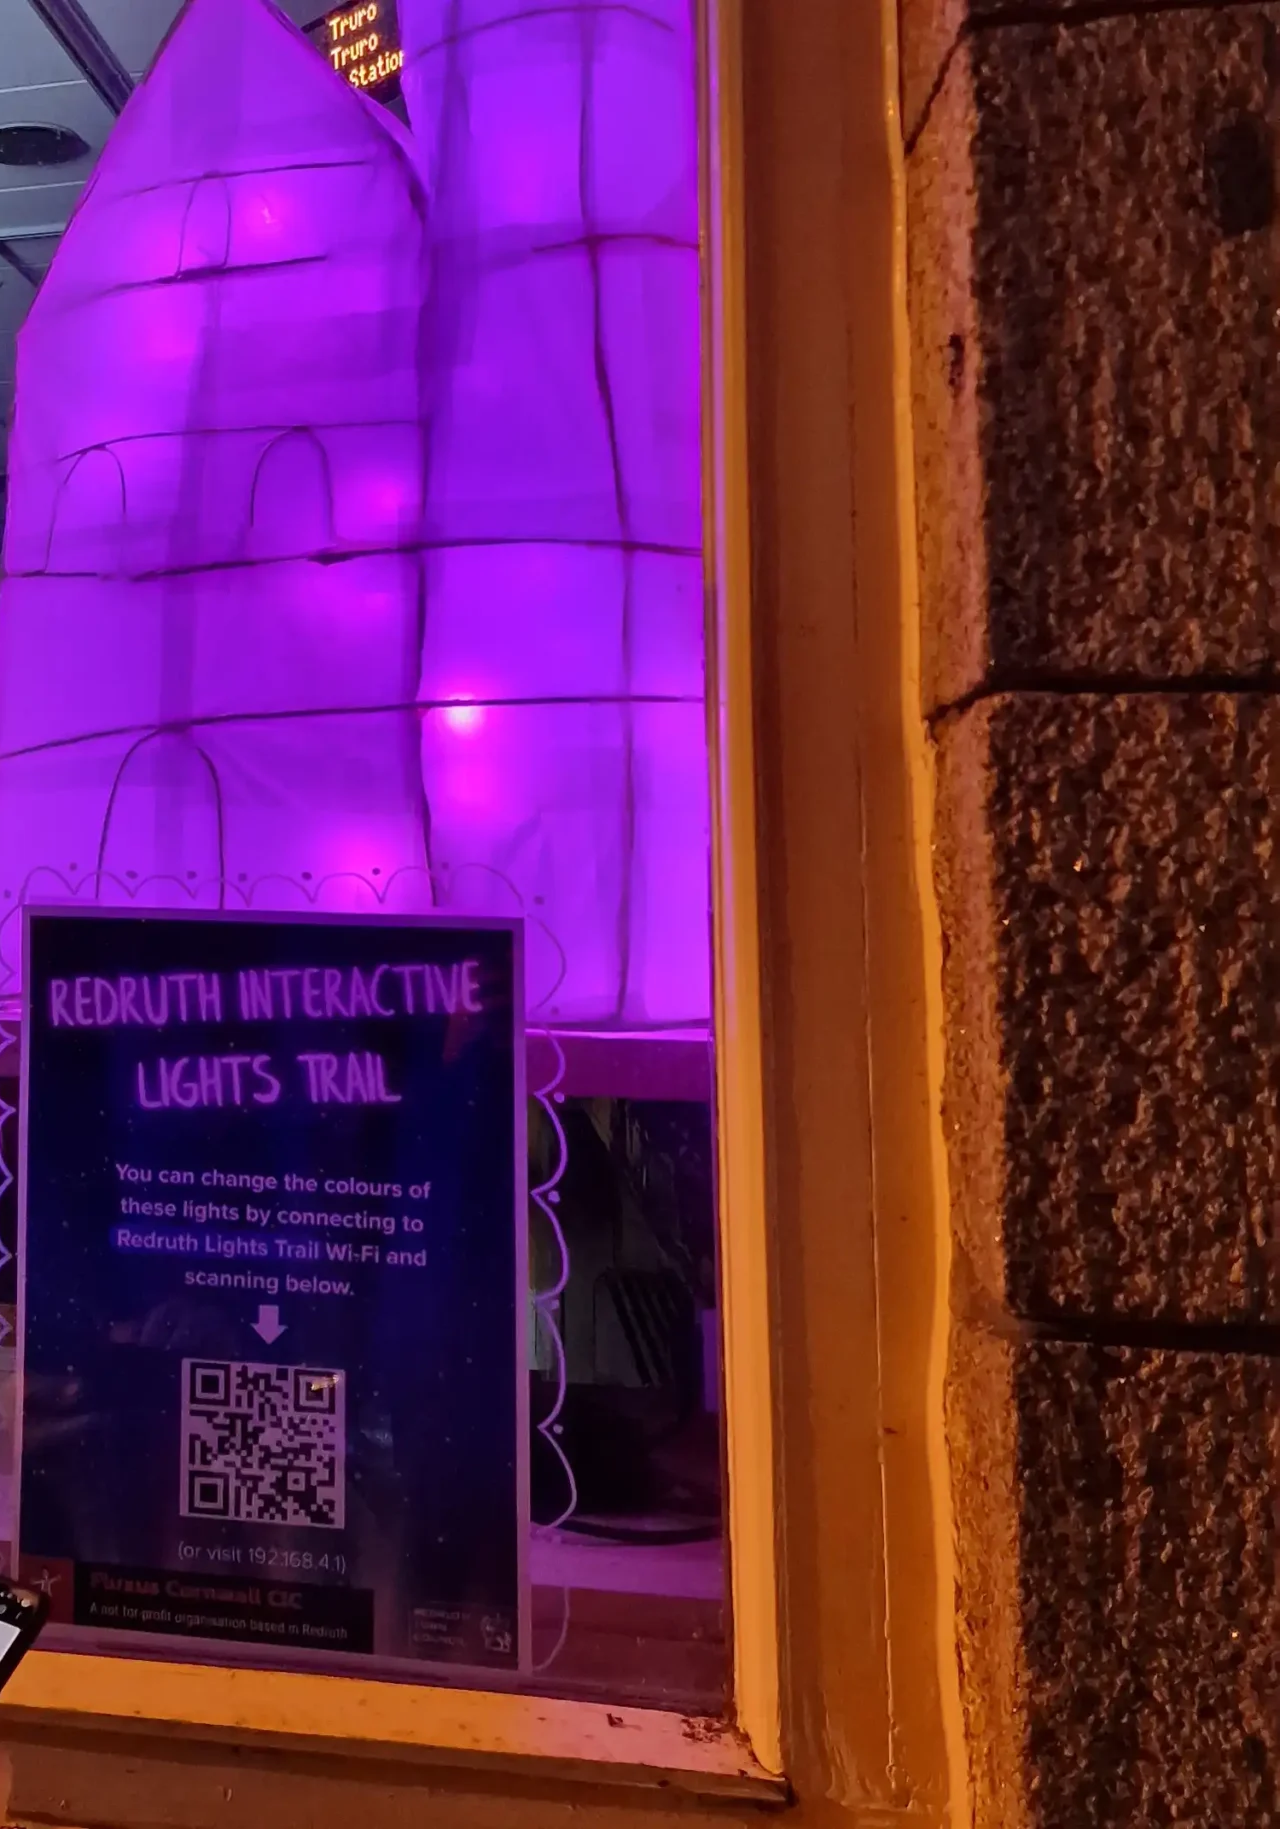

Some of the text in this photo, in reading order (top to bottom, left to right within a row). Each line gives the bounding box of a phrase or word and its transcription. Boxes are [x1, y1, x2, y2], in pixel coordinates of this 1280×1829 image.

[328, 3, 377, 41] Truro
[330, 33, 379, 70] Truro
[50, 961, 484, 1027] REDRUTH INTERACTIVE
[137, 1051, 402, 1109] LIGHTS TRAIL
[116, 1163, 432, 1200] You can change the colours of
[120, 1197, 424, 1235] these lights by connecting to
[117, 1229, 427, 1268] Redruth Lights Trail Wi-Fi and
[185, 1268, 356, 1297] scanning below.
[177, 1540, 202, 1561] (or
[206, 1545, 242, 1564] visit
[89, 1601, 98, 1614] A
